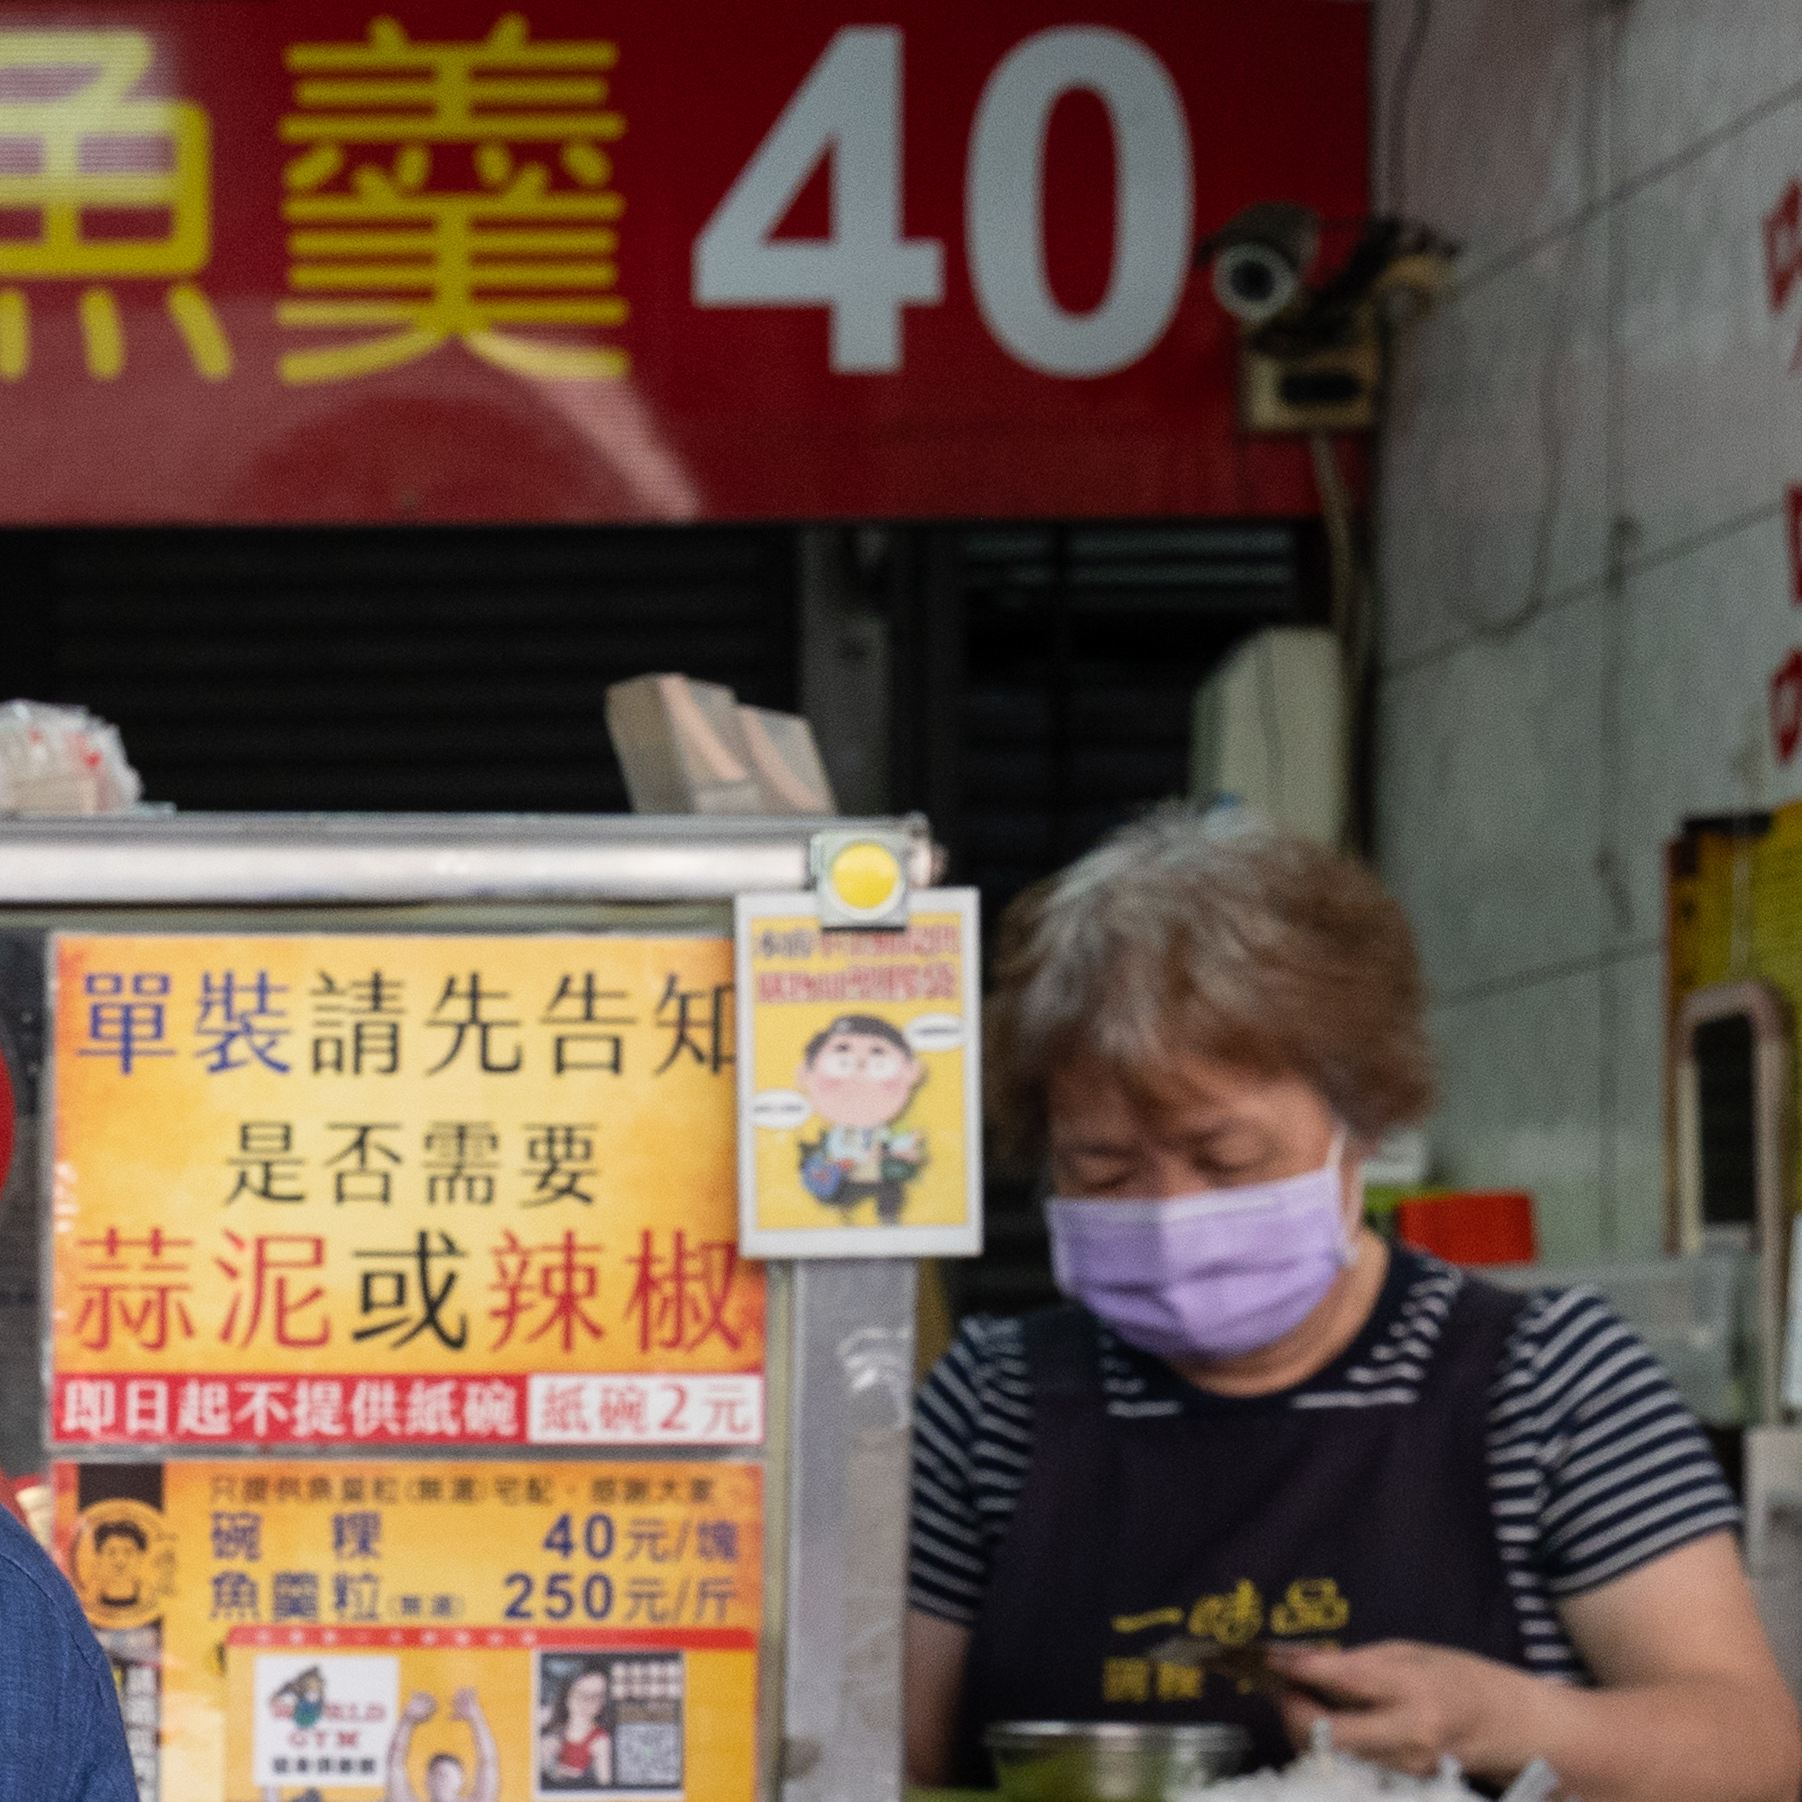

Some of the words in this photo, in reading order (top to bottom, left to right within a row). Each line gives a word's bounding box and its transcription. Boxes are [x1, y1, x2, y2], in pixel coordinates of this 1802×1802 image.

[692, 24, 1194, 377] 40
[76, 969, 736, 1077] 單裝請先告知
[223, 1120, 600, 1208] 是否需要
[74, 1225, 745, 1356] 蒜泥或辣椒
[62, 1379, 518, 1439] 即日起不提供紙碗
